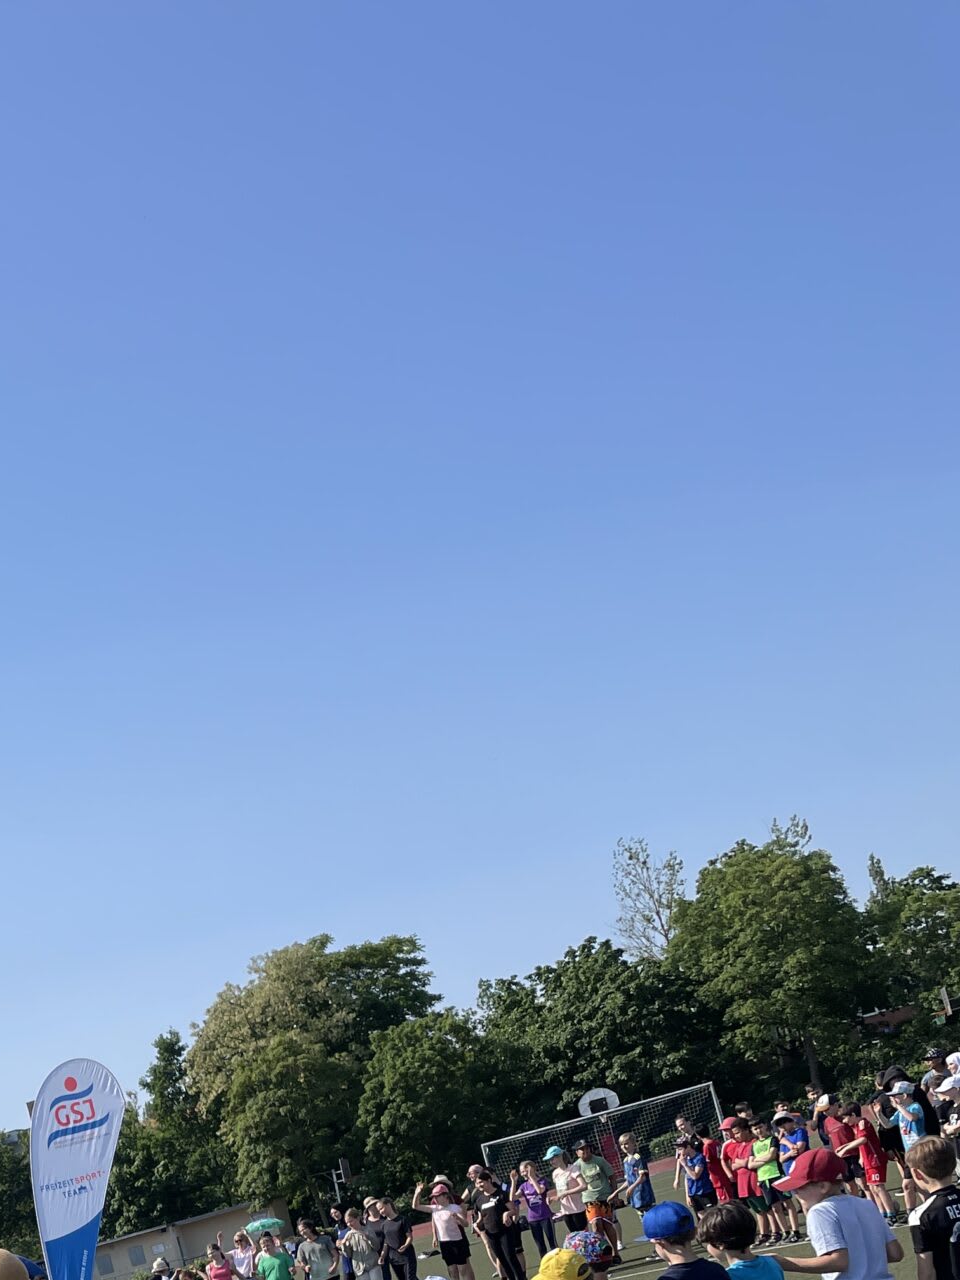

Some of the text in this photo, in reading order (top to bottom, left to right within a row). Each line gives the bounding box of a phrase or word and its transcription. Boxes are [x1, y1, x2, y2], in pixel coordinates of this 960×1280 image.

[54, 1098, 96, 1127] GSJ
[871, 1173, 880, 1181] 10
[946, 1203, 960, 1220] RE
